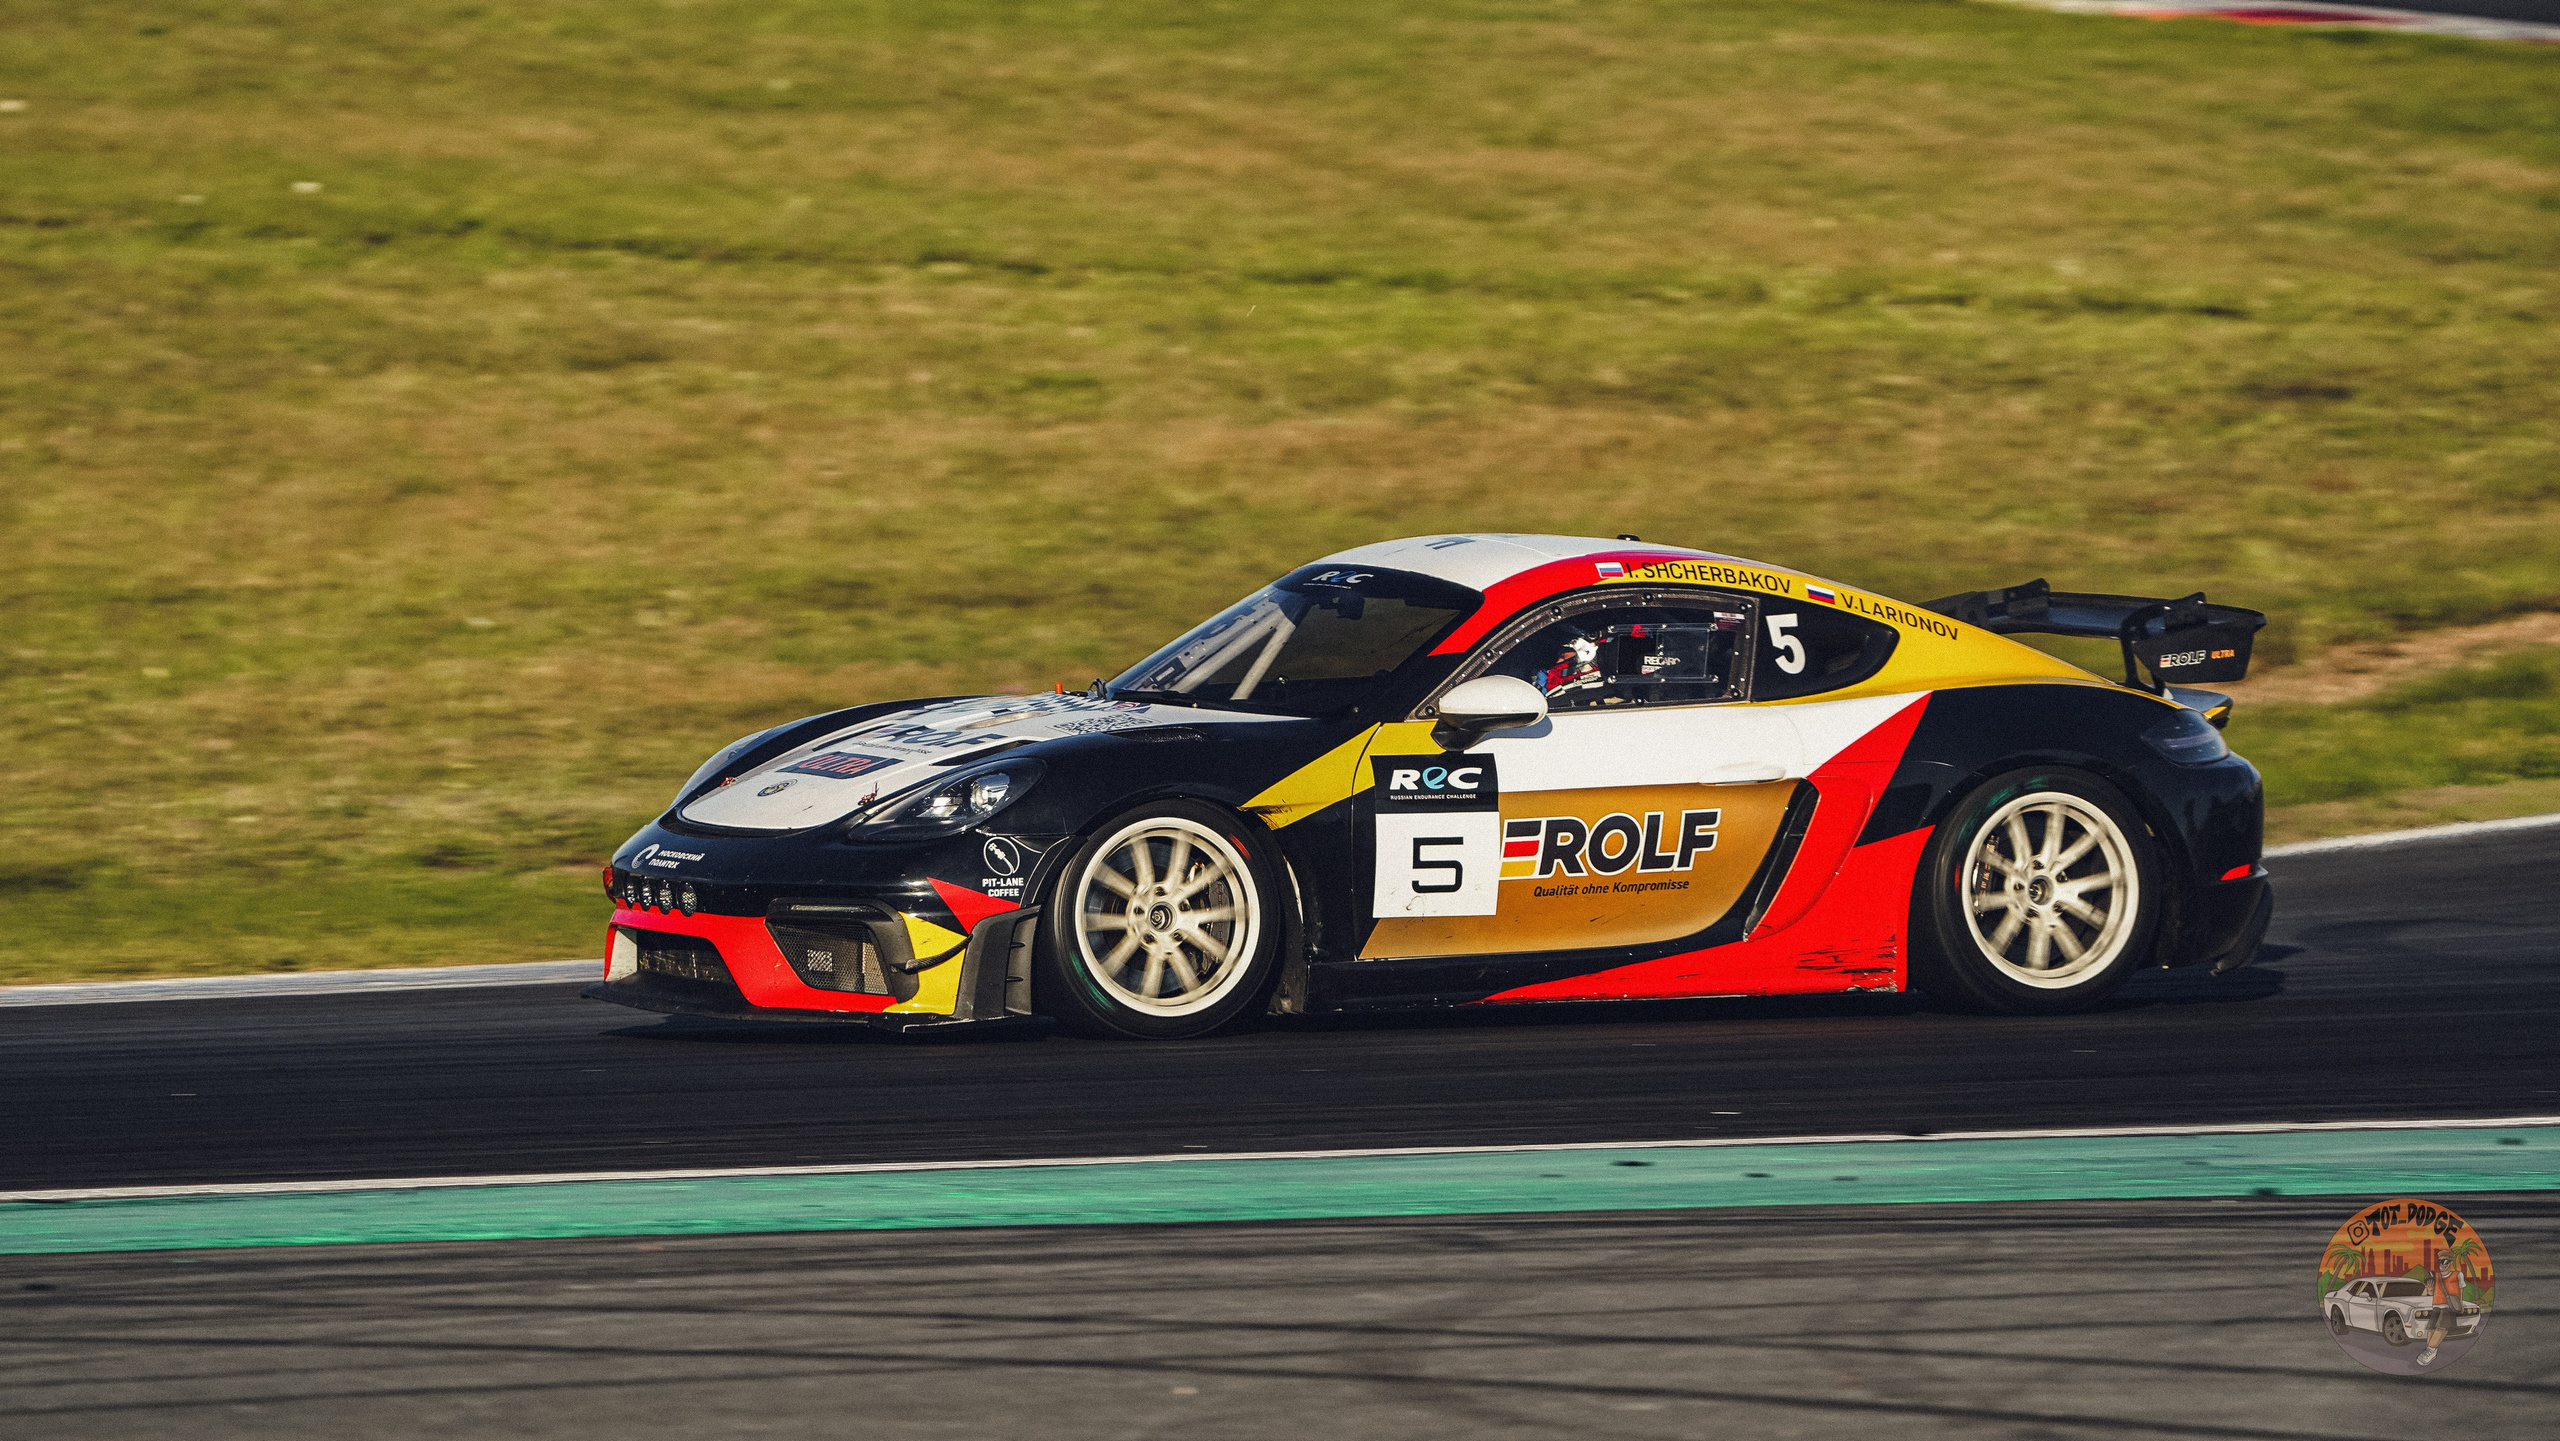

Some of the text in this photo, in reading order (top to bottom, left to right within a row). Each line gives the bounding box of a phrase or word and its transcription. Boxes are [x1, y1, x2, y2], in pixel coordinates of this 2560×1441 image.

[1625, 562, 1791, 594] I. SHCHERBAKOV
[1765, 613, 1806, 674] 5
[2169, 649, 2235, 667] ROLF ULTRA
[798, 753, 878, 775] ULTRA
[1537, 807, 1722, 877] ROLF
[1411, 836, 1464, 894] 5
[982, 877, 1024, 887] PIT-LANE
[988, 888, 1020, 897] COFFEE
[1533, 878, 1690, 897] Qualität ohne Kompromisse
